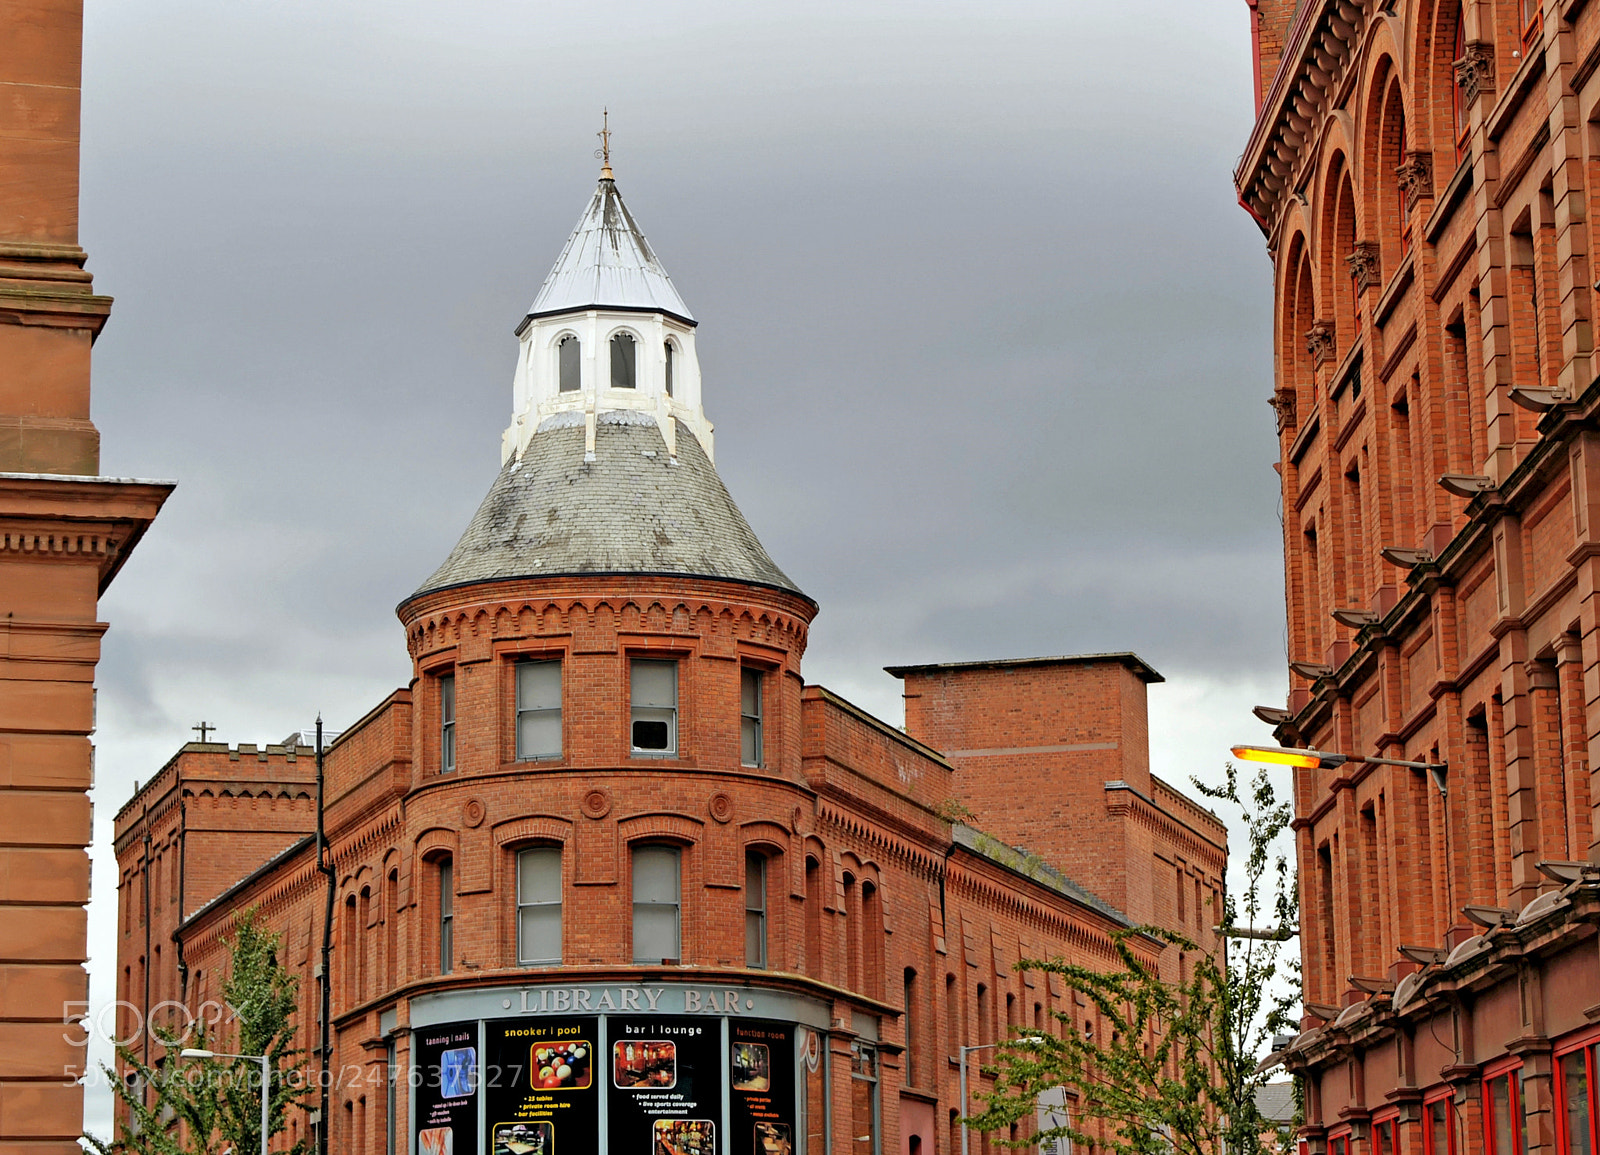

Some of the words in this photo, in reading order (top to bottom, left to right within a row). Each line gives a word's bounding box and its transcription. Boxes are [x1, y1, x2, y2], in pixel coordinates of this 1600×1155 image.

[519, 988, 665, 1013] LIBRARY
[683, 989, 741, 1014] BAR
[504, 1027, 547, 1037] snooker
[557, 1025, 581, 1037] pool
[625, 1024, 646, 1034] bar
[660, 1024, 703, 1036] lounge
[736, 1026, 765, 1038] function
[767, 1032, 785, 1040] room
[425, 1035, 449, 1046] tanning
[455, 1032, 470, 1042] nails
[636, 1093, 650, 1101] food
[669, 1093, 684, 1101] daily
